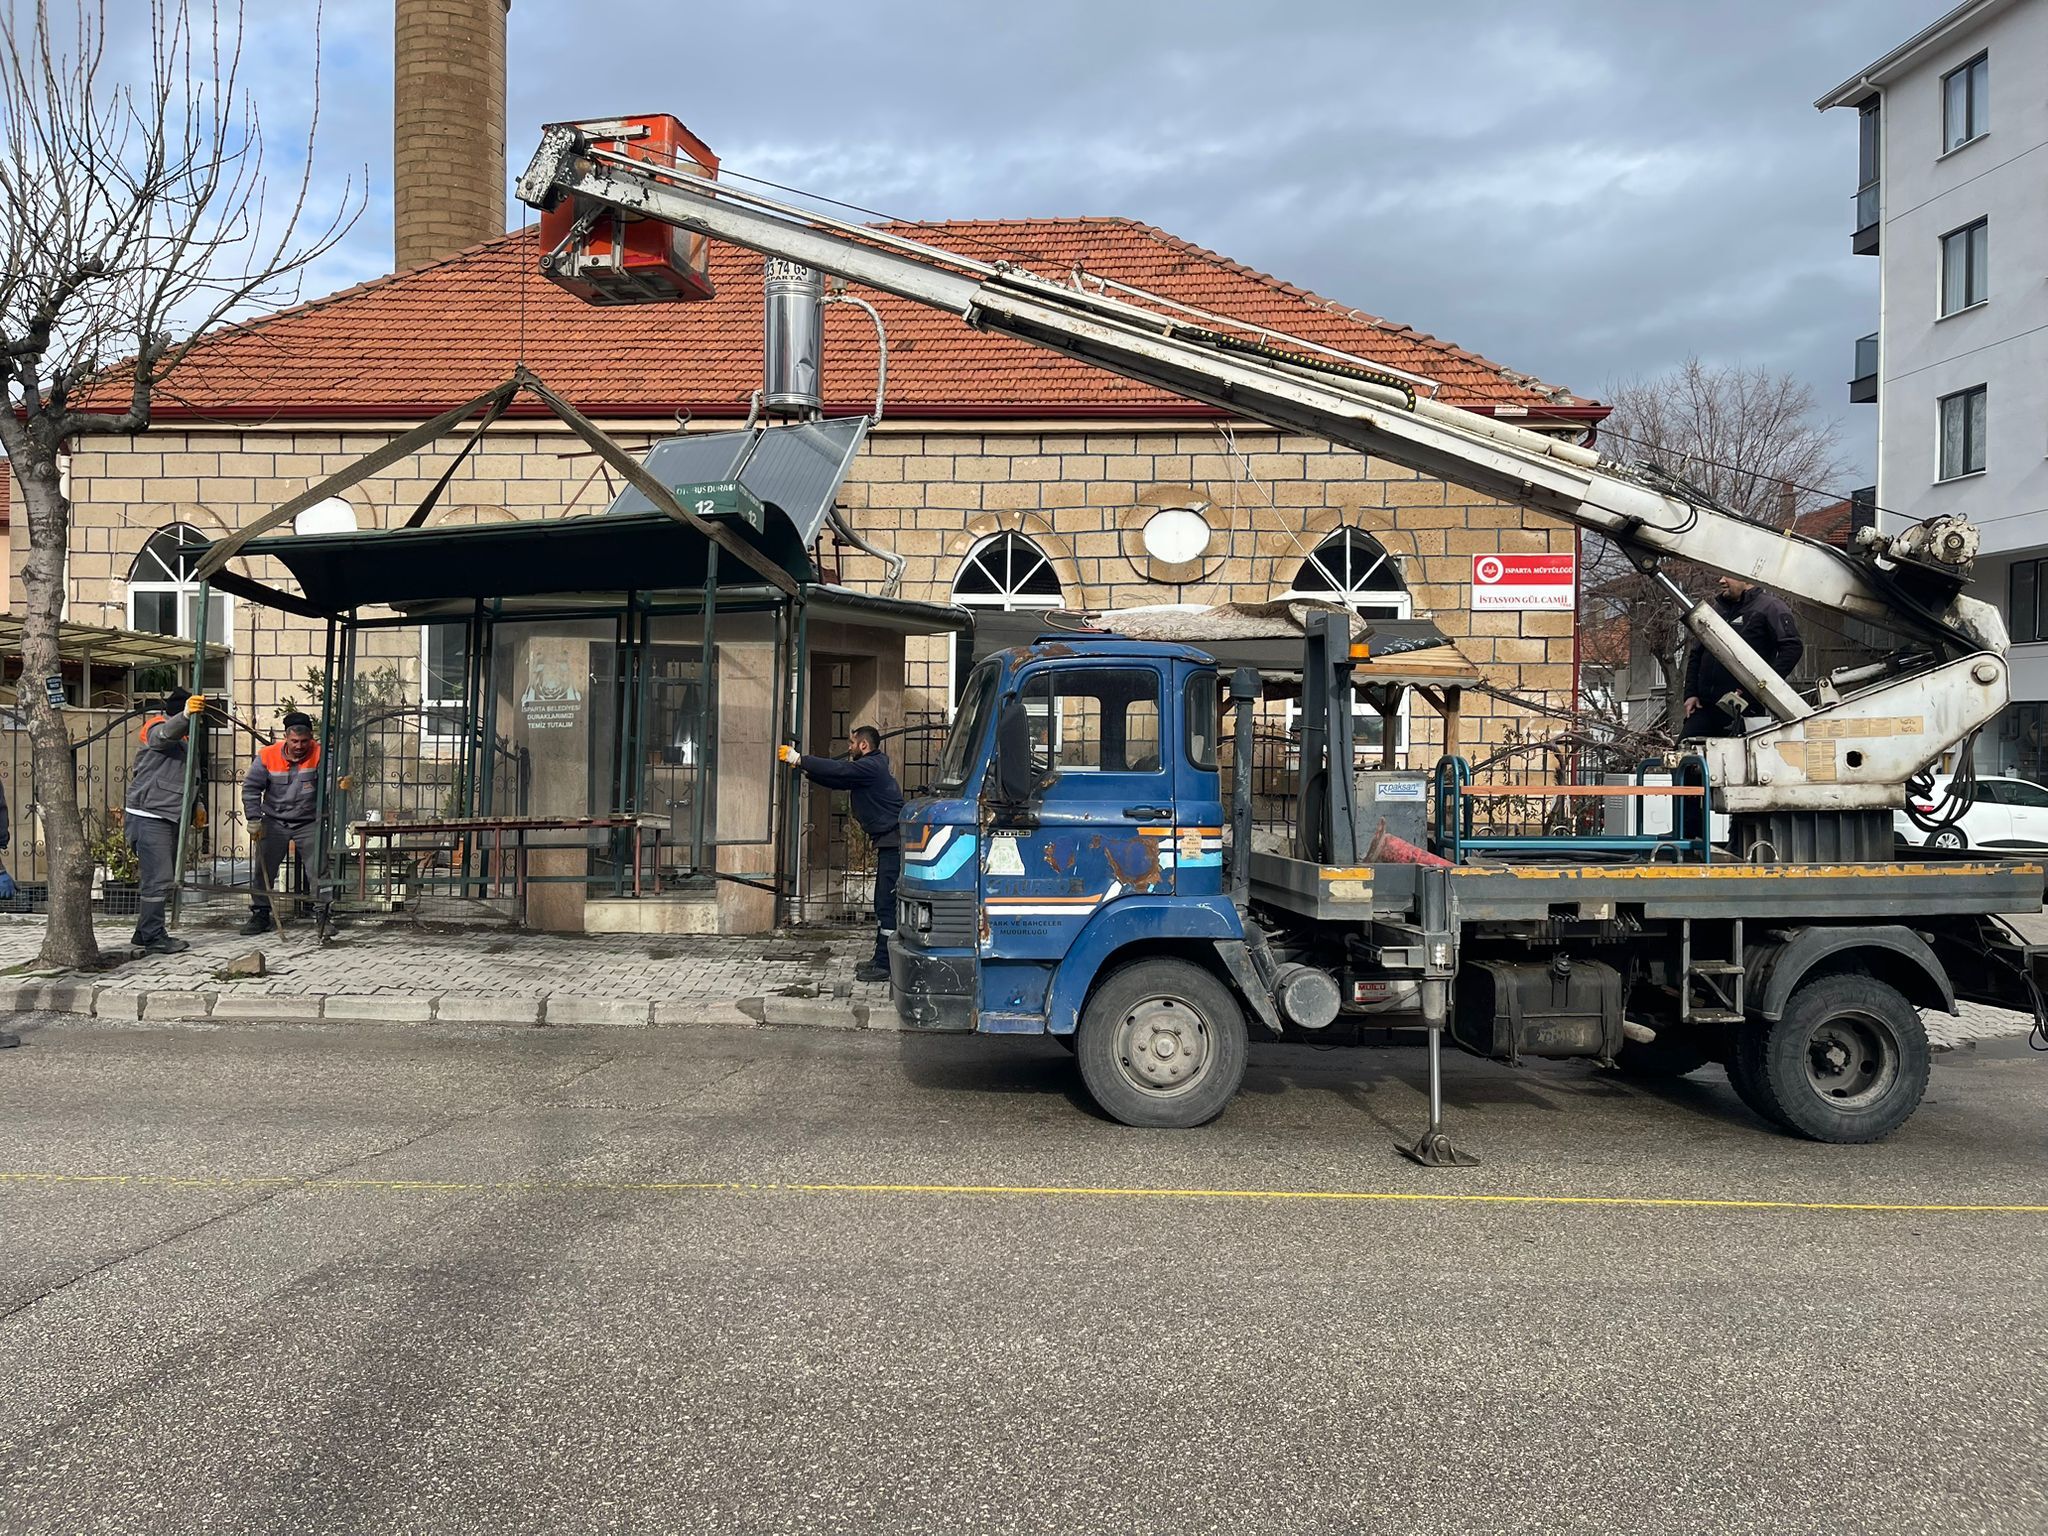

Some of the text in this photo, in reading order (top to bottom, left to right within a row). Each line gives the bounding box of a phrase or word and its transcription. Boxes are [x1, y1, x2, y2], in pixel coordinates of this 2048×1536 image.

[778, 260, 789, 275] 74
[695, 500, 714, 514] 12
[748, 510, 757, 527] 12
[1522, 595, 1540, 604] GÜL
